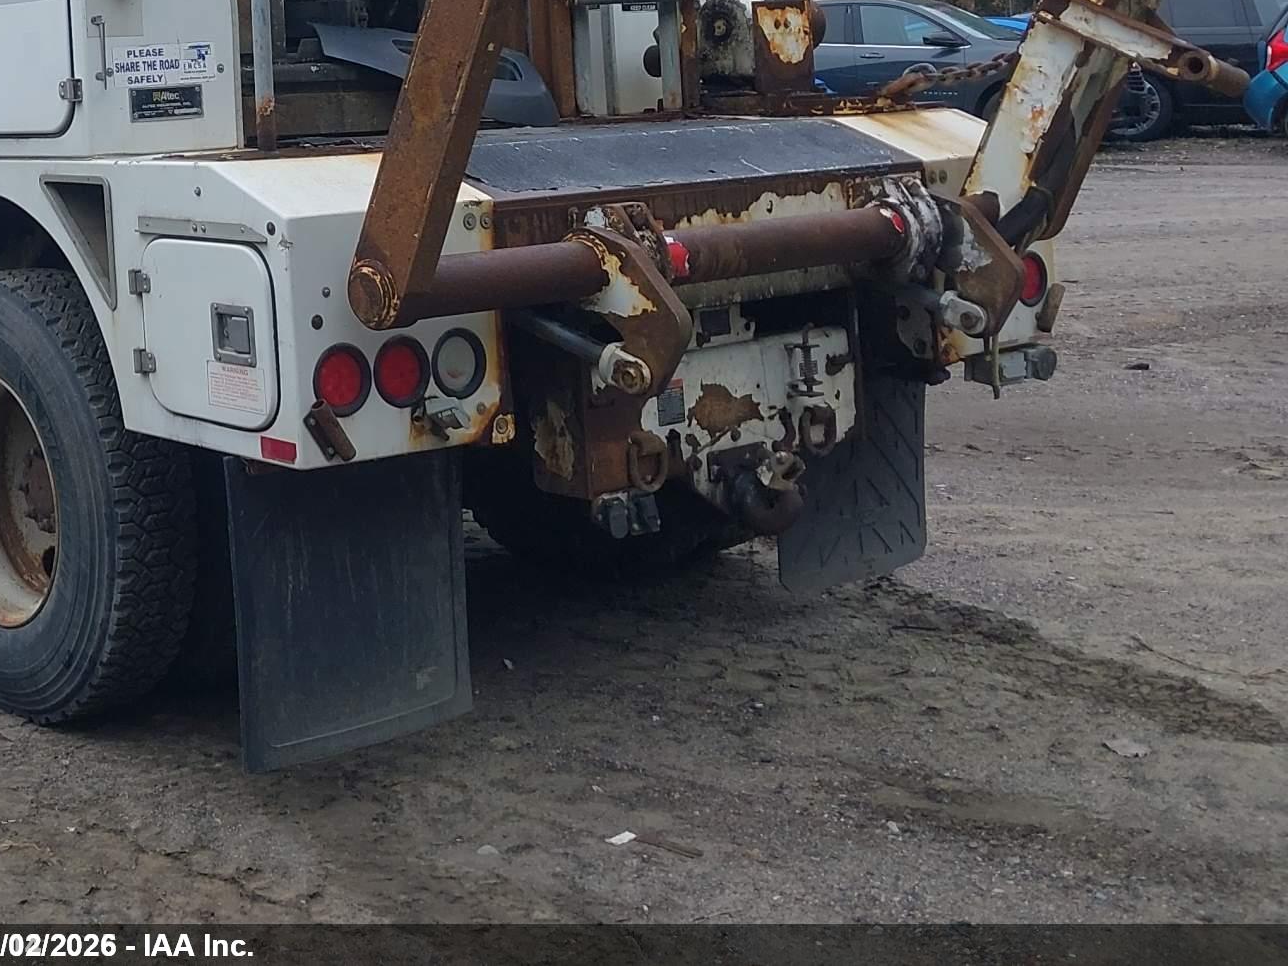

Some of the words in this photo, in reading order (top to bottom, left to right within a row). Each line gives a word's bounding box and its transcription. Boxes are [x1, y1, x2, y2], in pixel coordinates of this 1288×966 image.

[126, 48, 164, 58] PLEASE
[115, 61, 140, 73] SHARE
[143, 60, 158, 72] THE
[161, 59, 180, 70] ROAD
[127, 74, 164, 85] SAFELY
[161, 91, 180, 101] Altec
